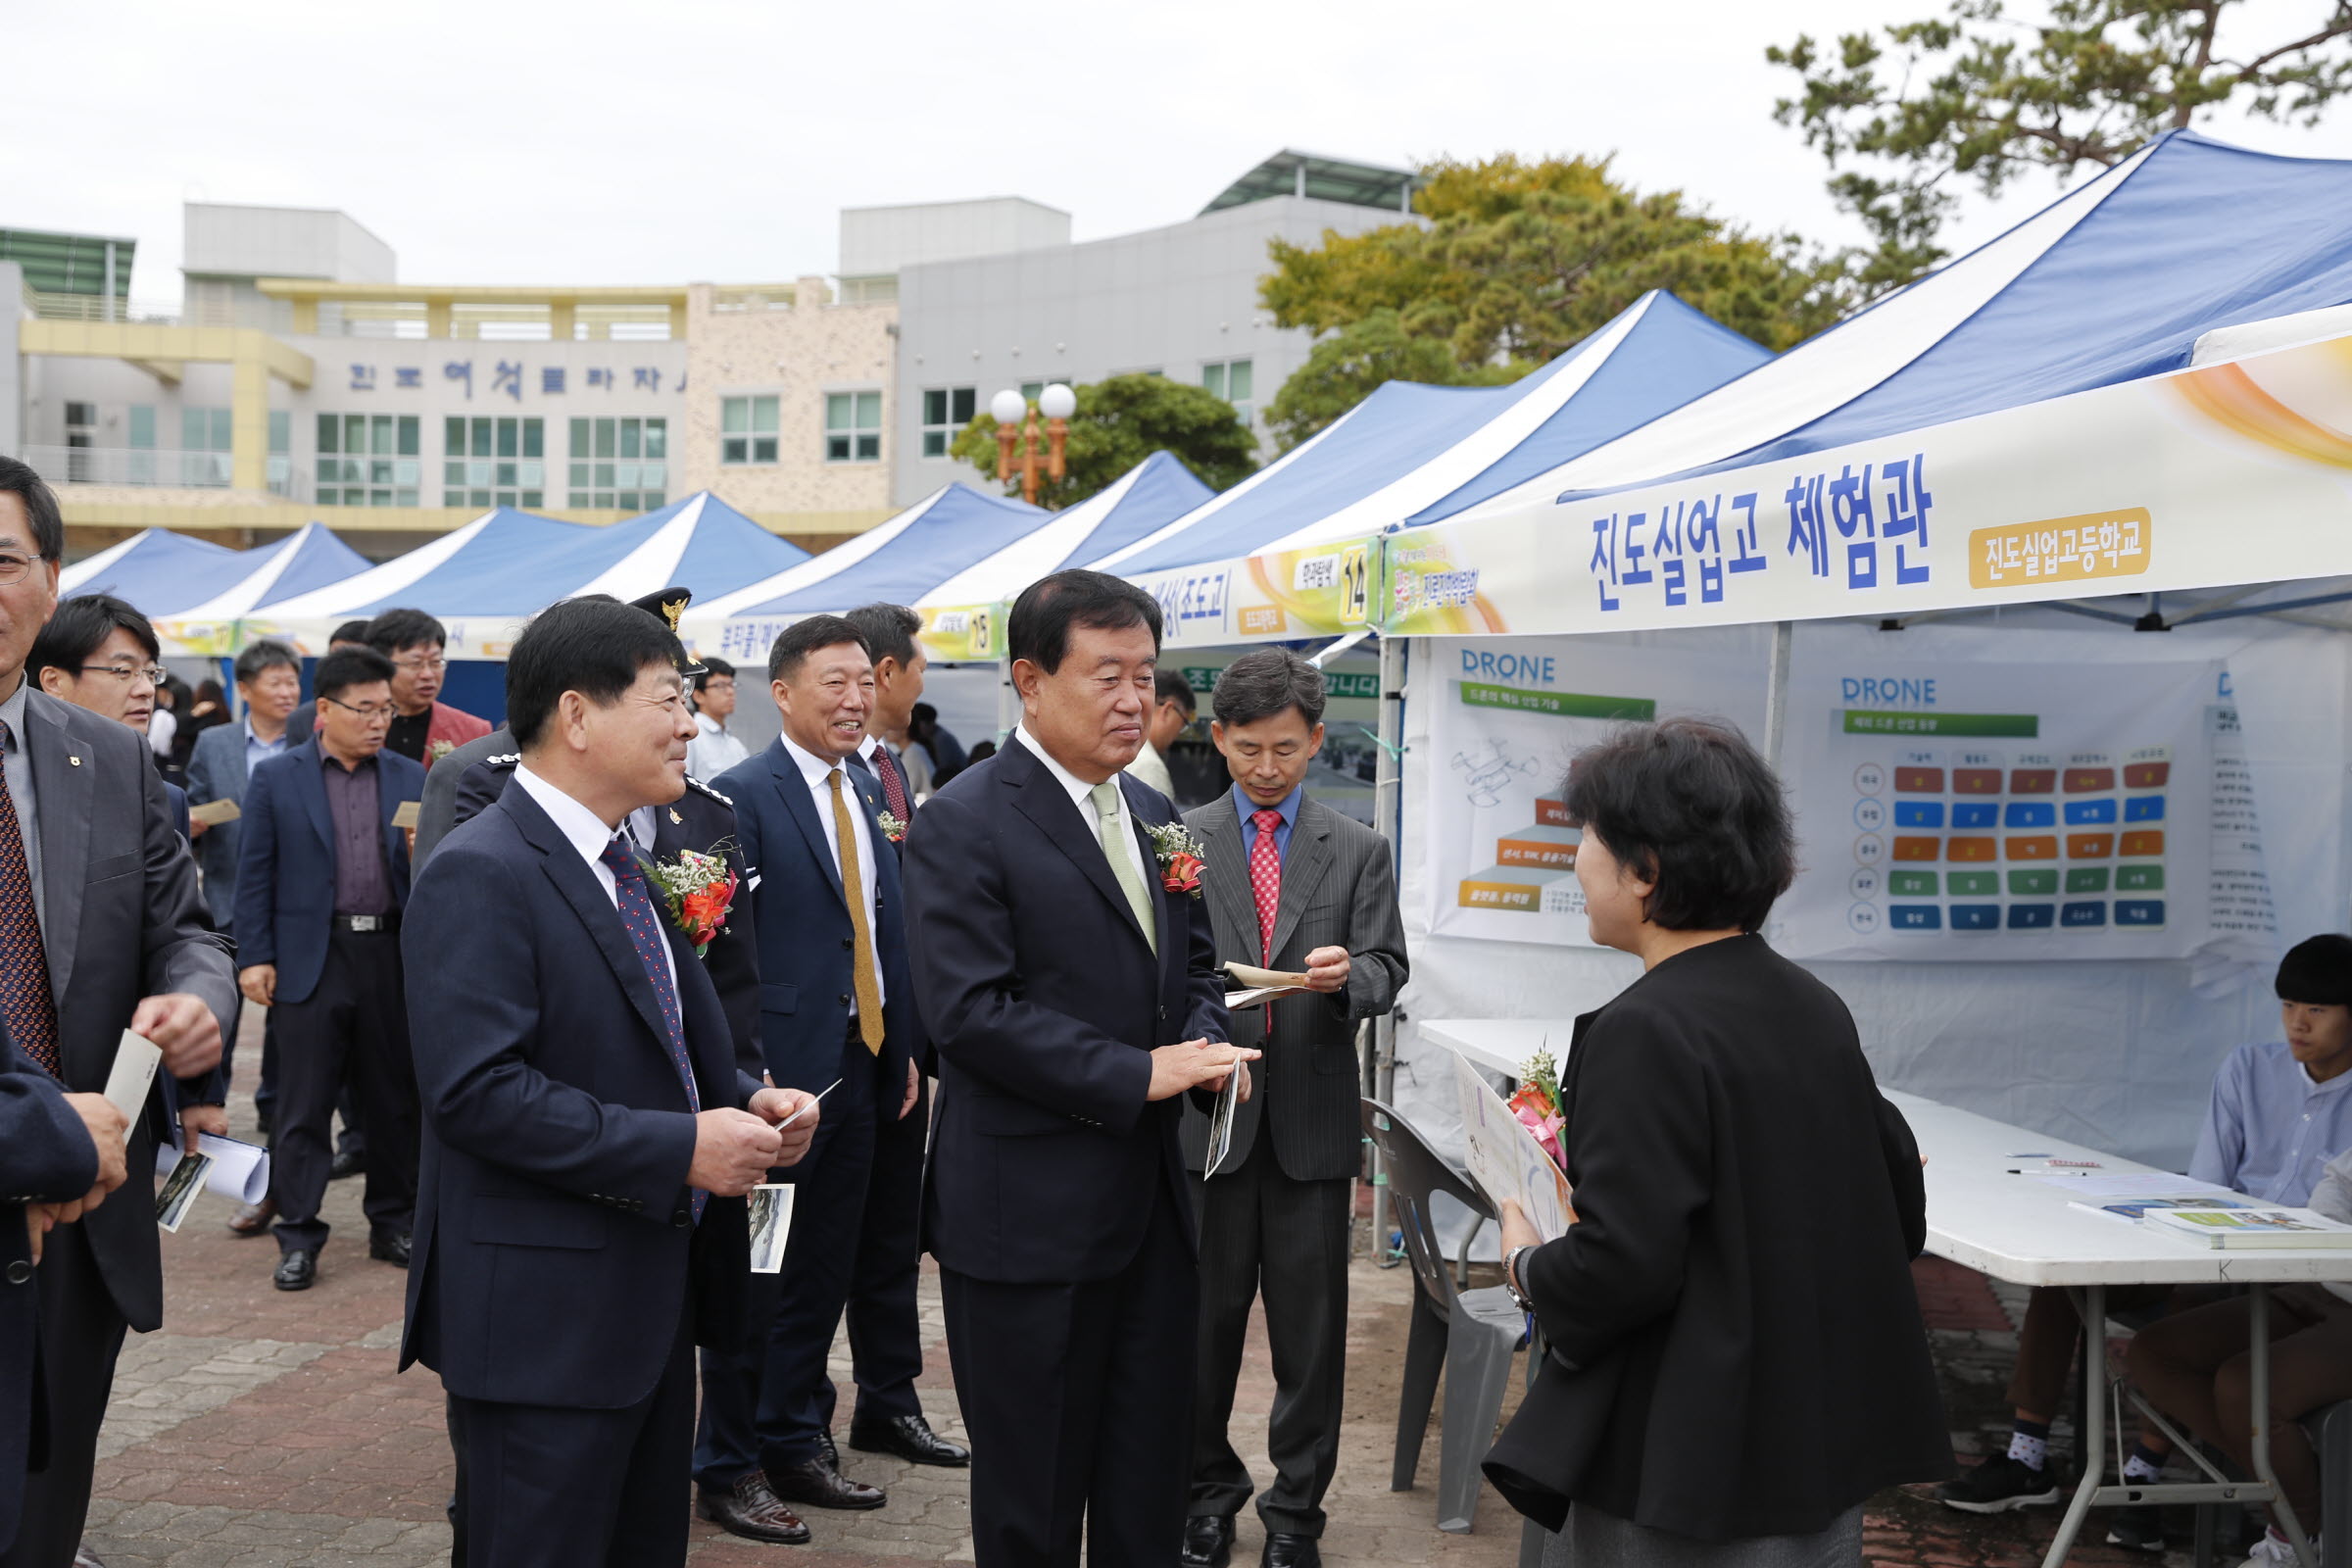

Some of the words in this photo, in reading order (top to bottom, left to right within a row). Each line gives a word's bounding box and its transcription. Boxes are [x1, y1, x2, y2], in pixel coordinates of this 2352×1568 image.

[1590, 491, 1767, 612] 진도실업고
[1785, 452, 1934, 590] 체험관
[1984, 519, 2142, 581] 진도실업고등학교
[1345, 554, 1364, 615] 14
[971, 613, 988, 649] 15
[1460, 648, 1556, 683] DRONE
[1541, 698, 1560, 710] 기술
[1841, 677, 1936, 704] DRONE
